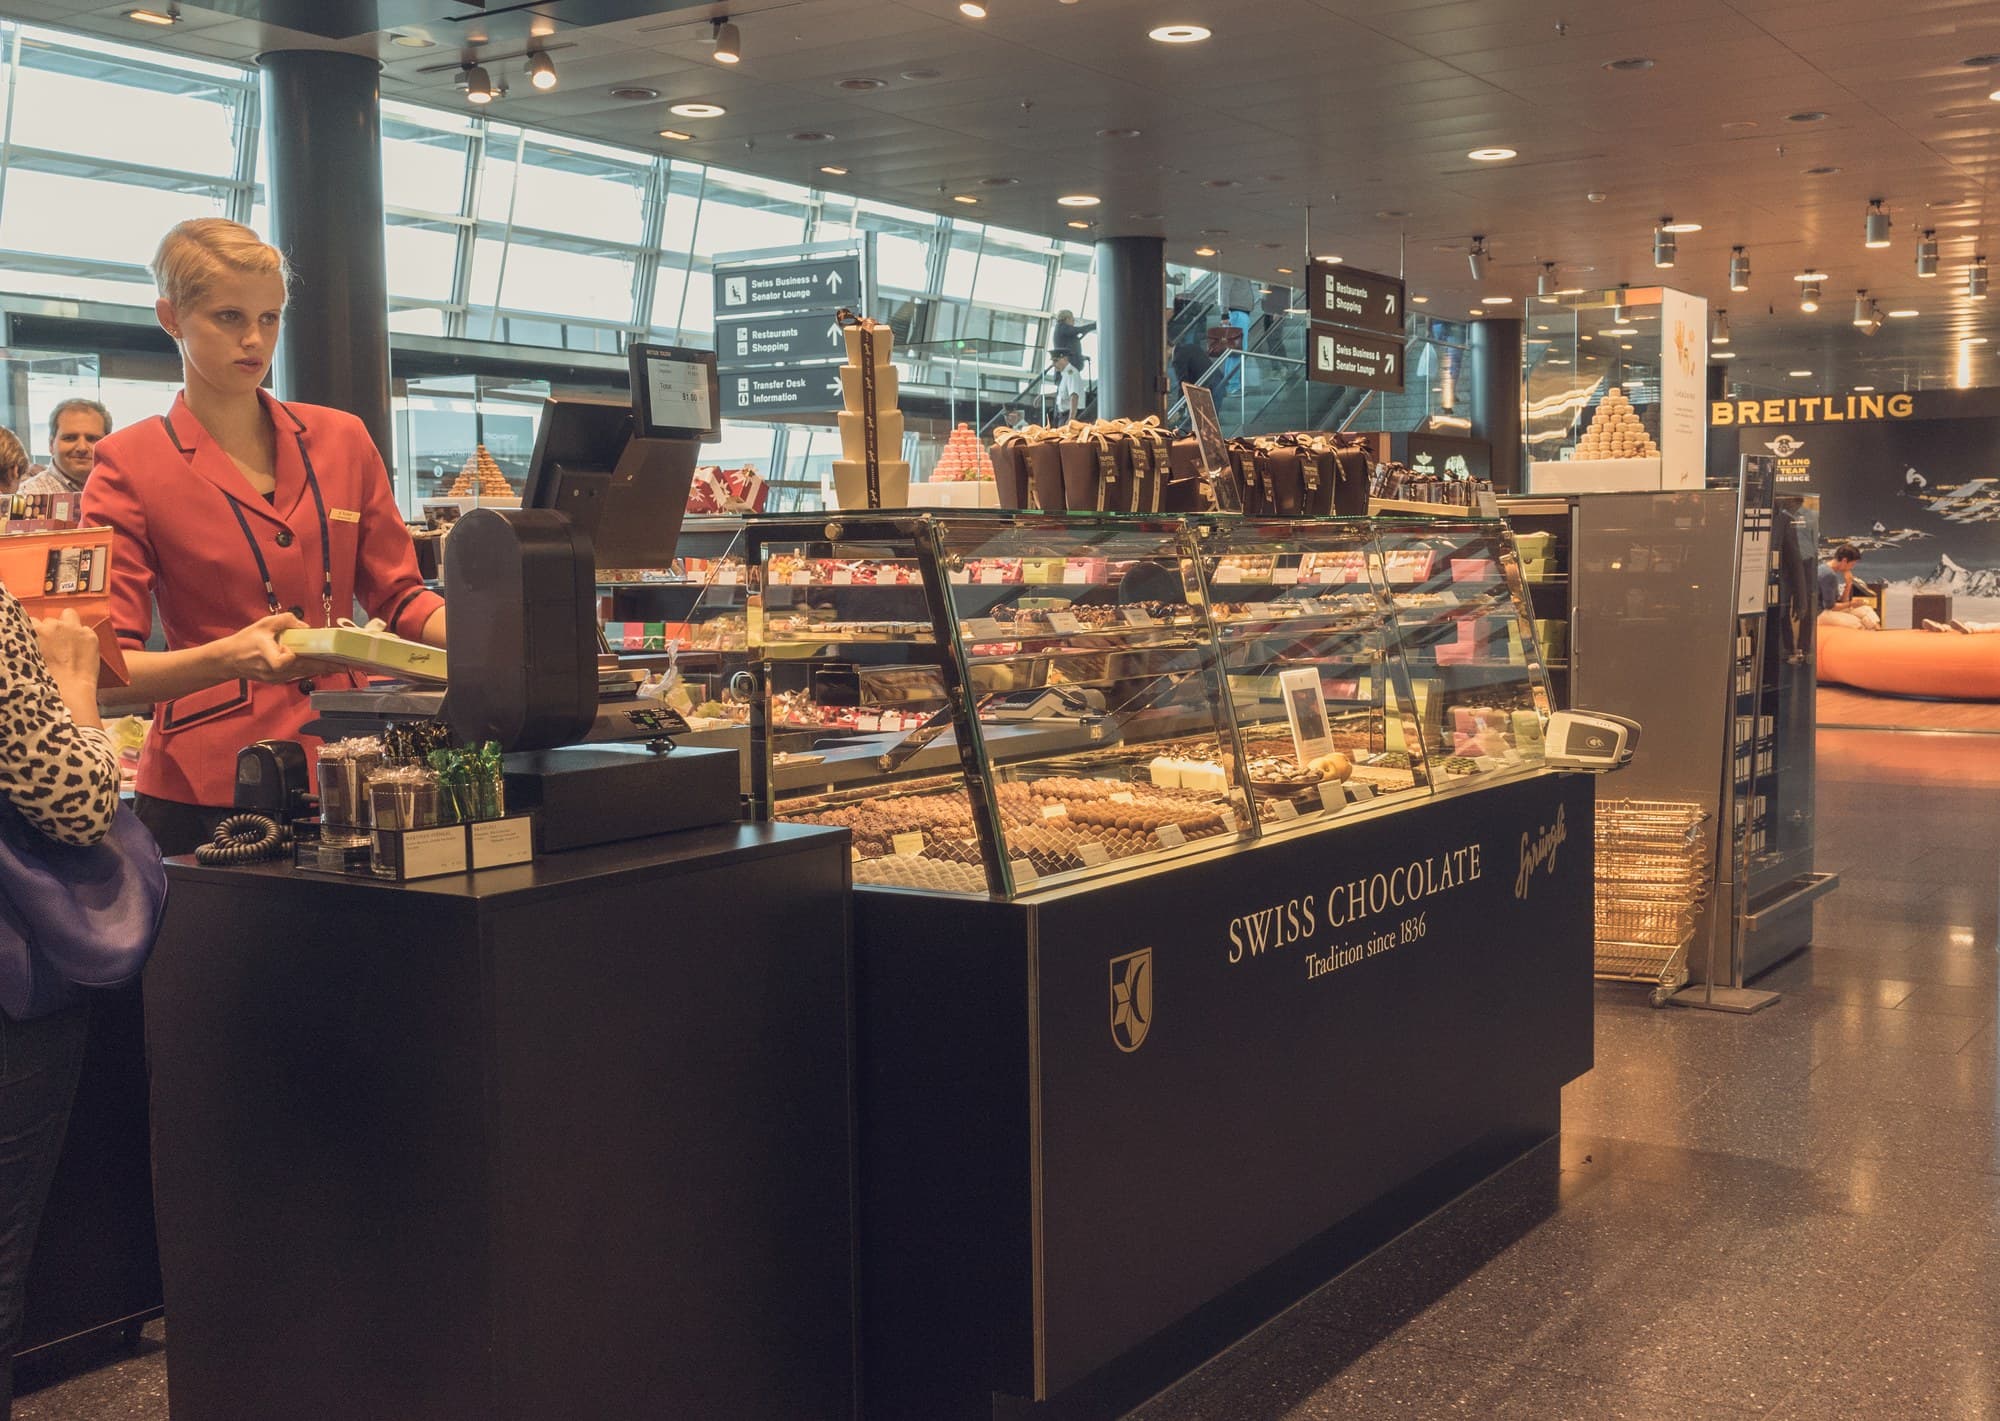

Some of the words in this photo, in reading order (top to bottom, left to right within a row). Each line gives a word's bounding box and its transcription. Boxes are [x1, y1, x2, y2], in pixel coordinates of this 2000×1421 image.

[751, 279, 774, 289] Swiss
[775, 275, 810, 287] Business
[811, 274, 819, 283] &
[751, 291, 781, 302] Senator
[782, 289, 811, 299] Lounge
[1336, 281, 1368, 299] Restaurants
[1336, 297, 1362, 314] Shopping
[752, 327, 798, 339] Restaurants
[752, 342, 789, 353] Shopping
[1336, 343, 1352, 356] Swiss
[1352, 346, 1375, 360] Business
[1336, 359, 1357, 374] Senator
[1357, 362, 1375, 377] Lounge
[753, 380, 784, 390] Transfer
[785, 378, 807, 388] Desk
[753, 392, 797, 403] Information
[1711, 394, 1914, 426] BREITLING
[1777, 458, 1810, 466] ITLING
[1228, 895, 1316, 964] SWISS
[1328, 843, 1481, 928] CHOCOLATE
[1305, 941, 1364, 980] Tradition
[1367, 930, 1396, 958] since
[1399, 911, 1426, 945] 1836
